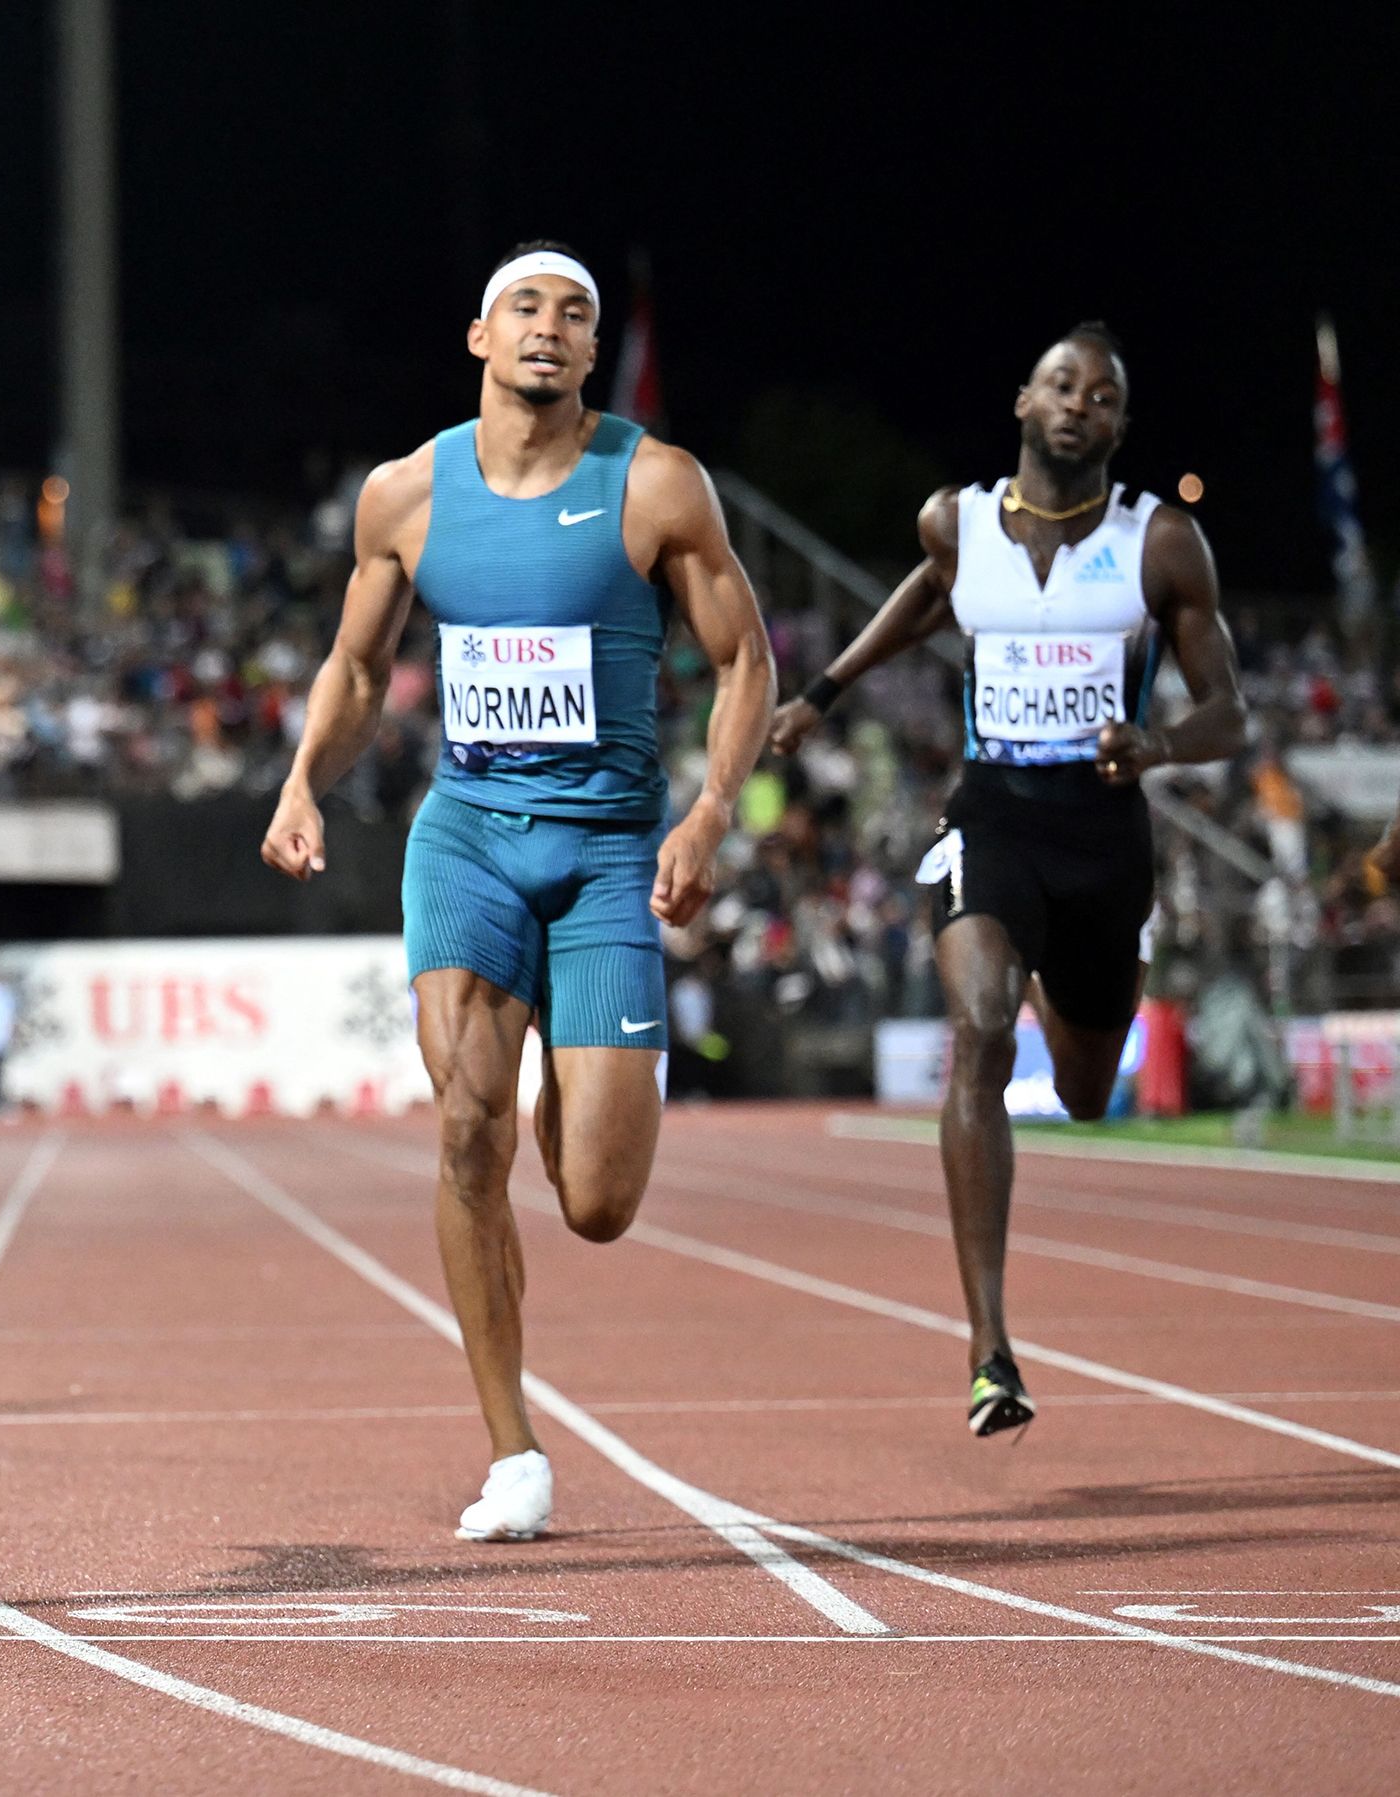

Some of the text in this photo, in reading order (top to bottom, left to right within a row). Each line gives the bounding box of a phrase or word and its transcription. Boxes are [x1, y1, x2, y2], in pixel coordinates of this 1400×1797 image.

[491, 637, 556, 664] UBS
[1034, 641, 1093, 667] UBS
[449, 682, 586, 731] NORMAN
[982, 684, 1116, 726] RICHARDS
[87, 971, 269, 1045] UBS
